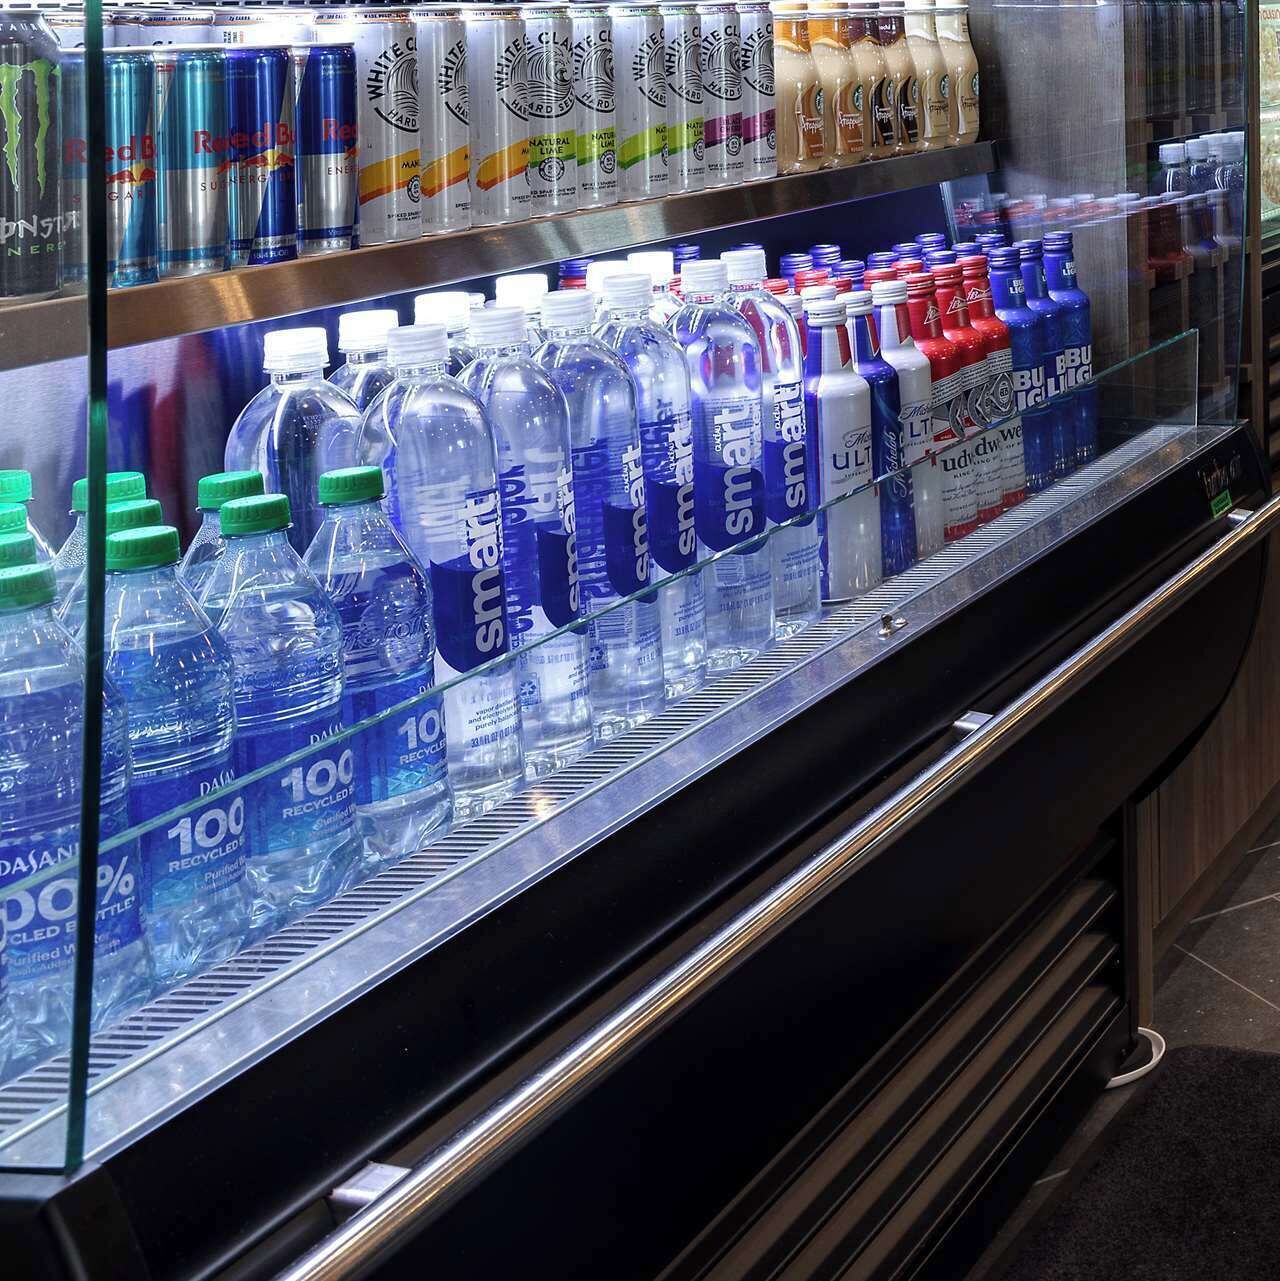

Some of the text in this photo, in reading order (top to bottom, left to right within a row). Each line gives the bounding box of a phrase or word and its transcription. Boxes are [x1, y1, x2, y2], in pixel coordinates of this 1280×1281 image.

[367, 41, 403, 101] WHITE
[440, 40, 466, 96] WHITE
[494, 37, 523, 93] WHITE
[632, 34, 658, 83] WHITE
[386, 107, 417, 130] HARD
[529, 138, 570, 149] NATURAL
[540, 146, 563, 155] LIME
[715, 408, 752, 536] smart
[774, 381, 806, 508] smart
[665, 412, 695, 556] smart
[622, 446, 650, 591] smart
[464, 493, 502, 653] smart
[282, 787, 349, 819] RECYCLED
[168, 839, 239, 872] RECYCLED
